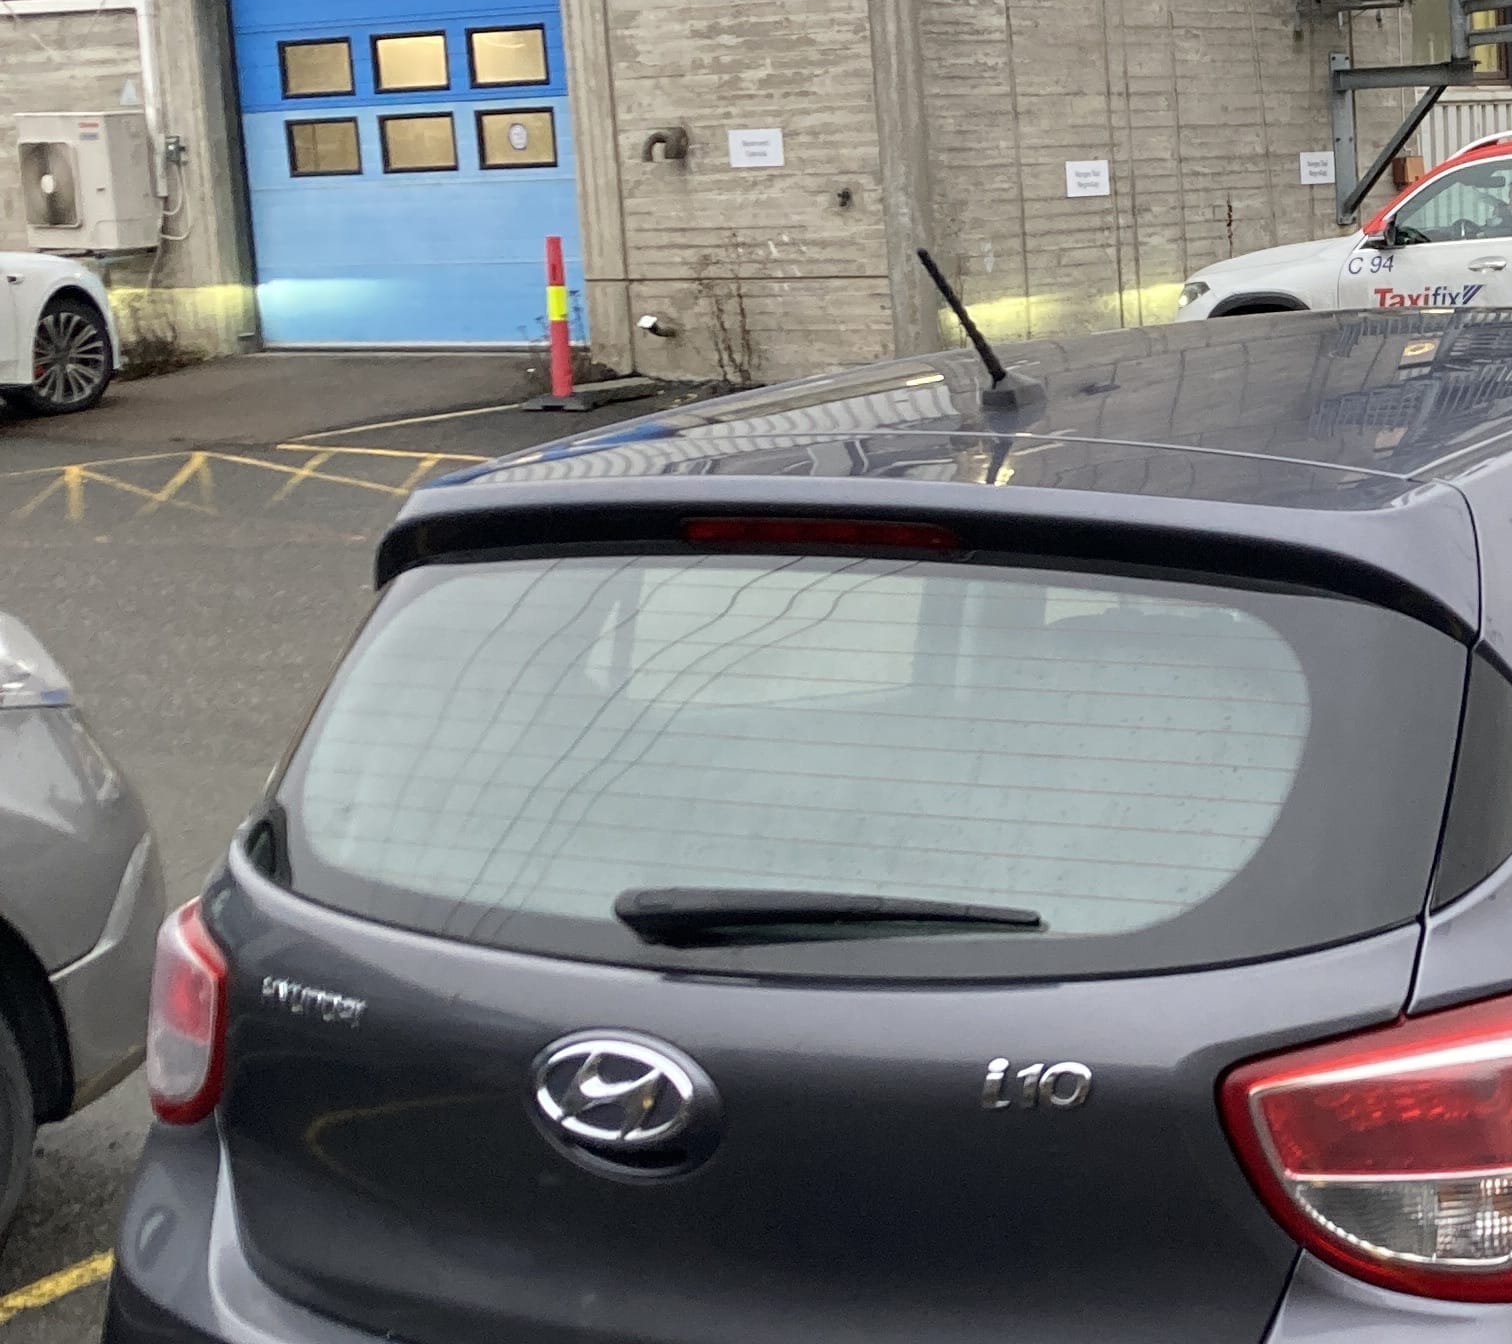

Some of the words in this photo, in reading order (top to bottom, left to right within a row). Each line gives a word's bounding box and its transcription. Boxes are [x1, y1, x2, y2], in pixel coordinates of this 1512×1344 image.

[1348, 257, 1364, 275] C
[1369, 255, 1394, 273] 94
[1374, 286, 1460, 308] Taxifix
[981, 1058, 1092, 1109] i10
